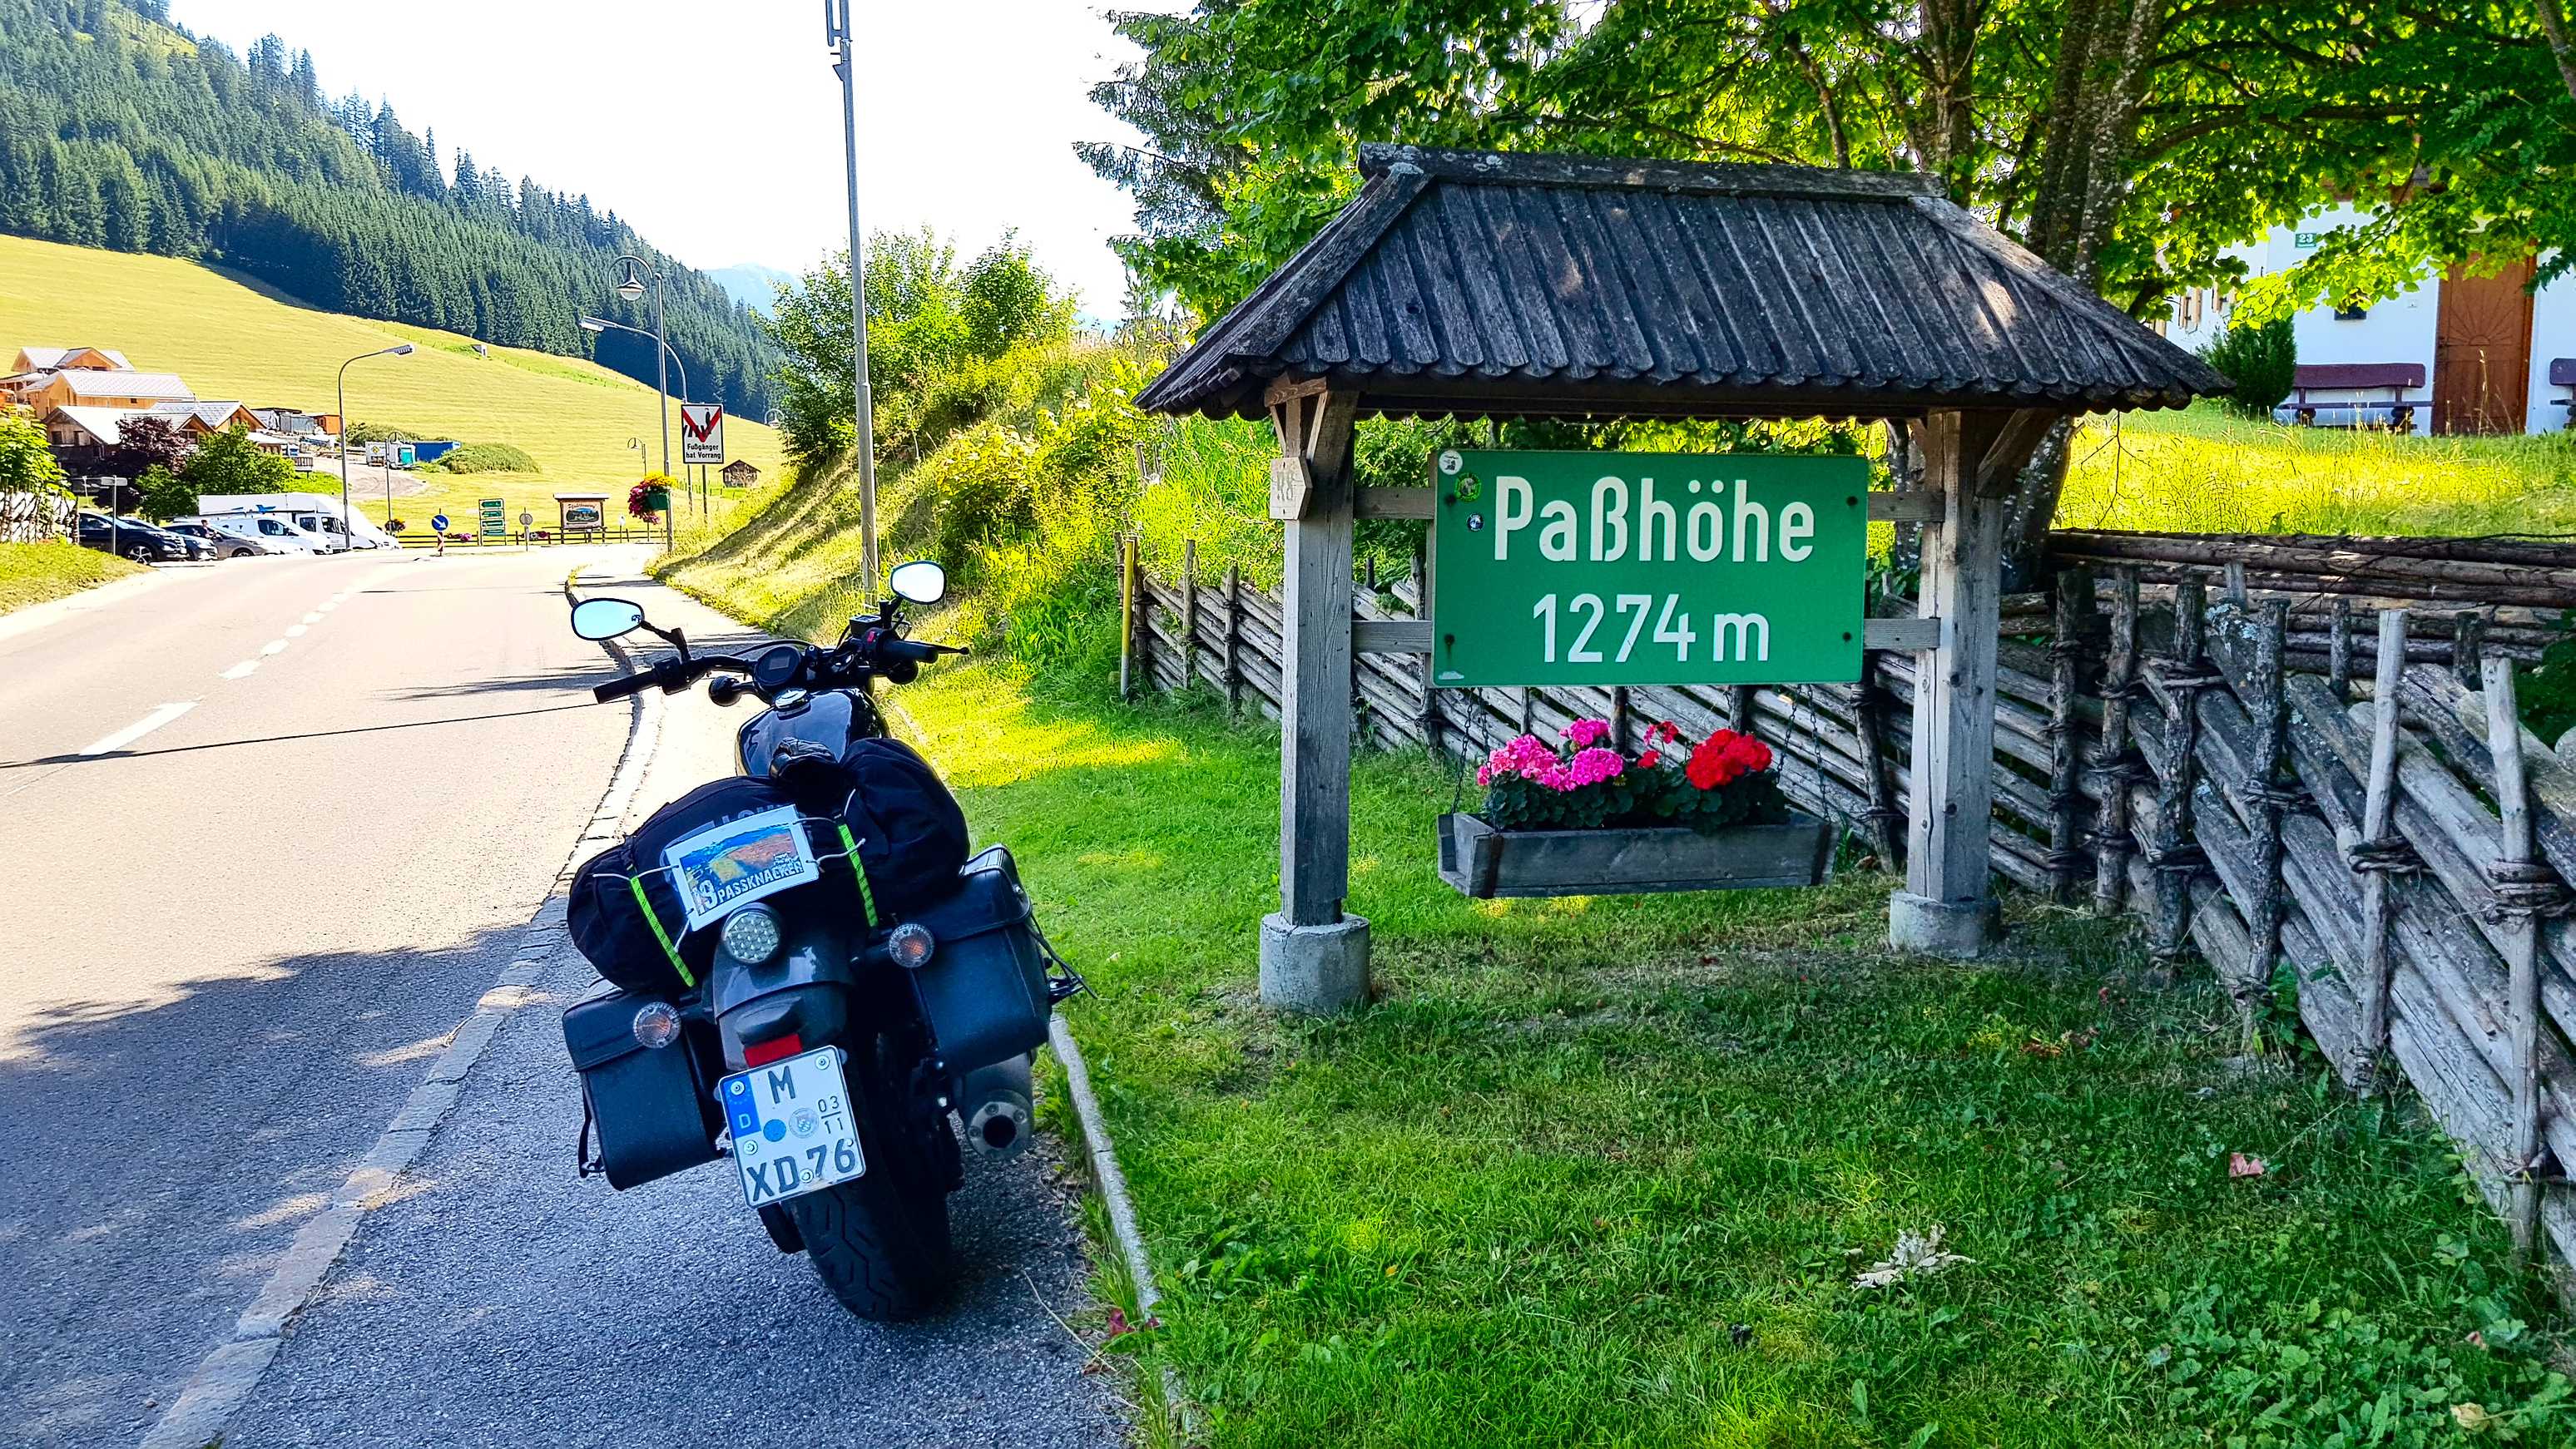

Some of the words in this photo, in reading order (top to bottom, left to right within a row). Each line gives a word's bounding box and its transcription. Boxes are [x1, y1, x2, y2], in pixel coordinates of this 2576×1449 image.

[2299, 234, 2313, 243] 23
[687, 443, 719, 452] Fußgänger
[1494, 476, 1815, 562] Paßhöhe
[1533, 593, 1697, 663] 1274
[1712, 612, 1770, 662] m
[718, 860, 805, 904] PASSKNACKER
[767, 1066, 795, 1104] M
[818, 1095, 840, 1113] 03
[738, 1113, 751, 1130] D
[824, 1117, 844, 1134] 11
